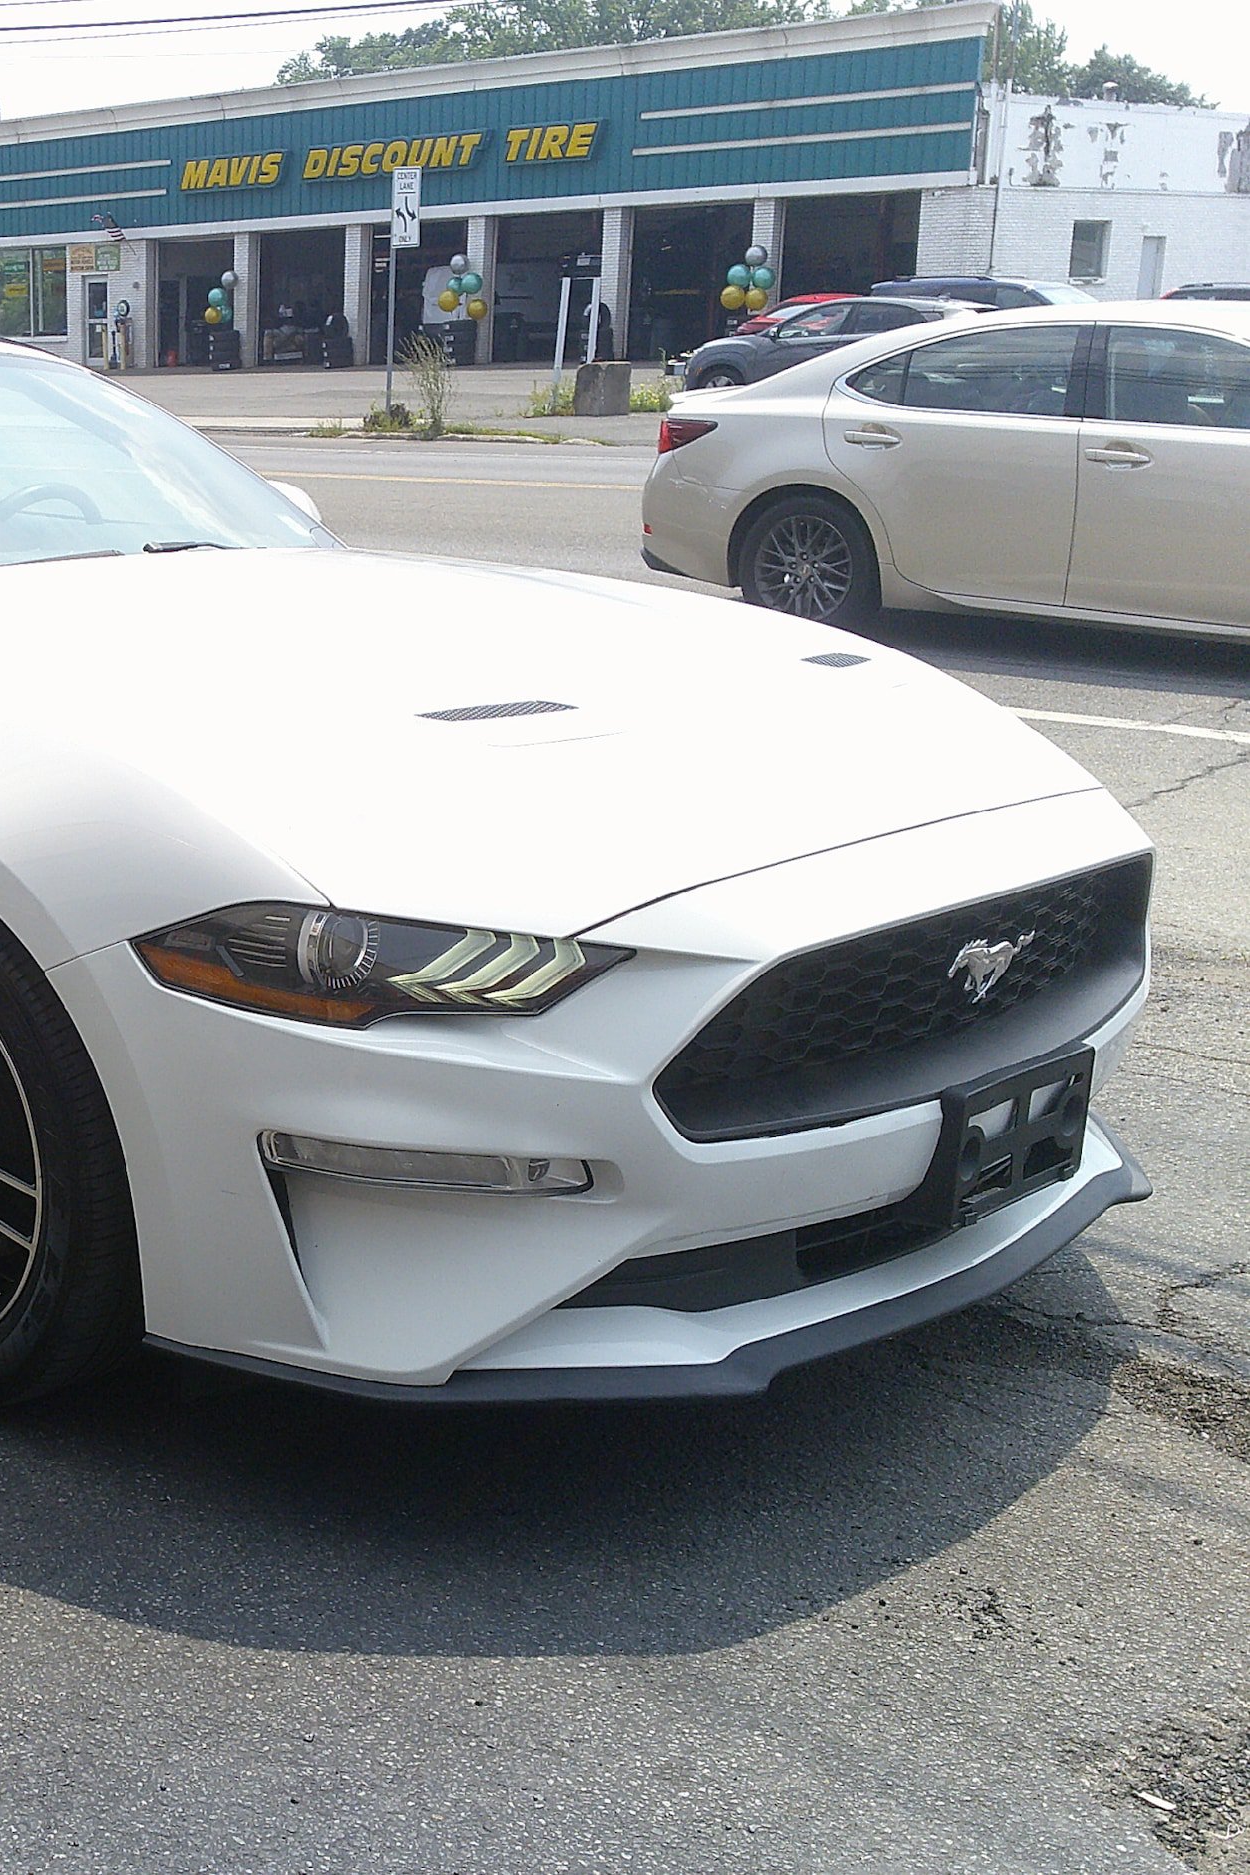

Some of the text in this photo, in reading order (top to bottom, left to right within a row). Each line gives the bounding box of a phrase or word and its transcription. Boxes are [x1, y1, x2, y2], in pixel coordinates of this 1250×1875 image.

[180, 122, 598, 190] MAVIS DISCOUNT TIRE
[397, 172, 417, 180] CENTER
[399, 182, 414, 190] LANE
[398, 235, 411, 243] ONLY
